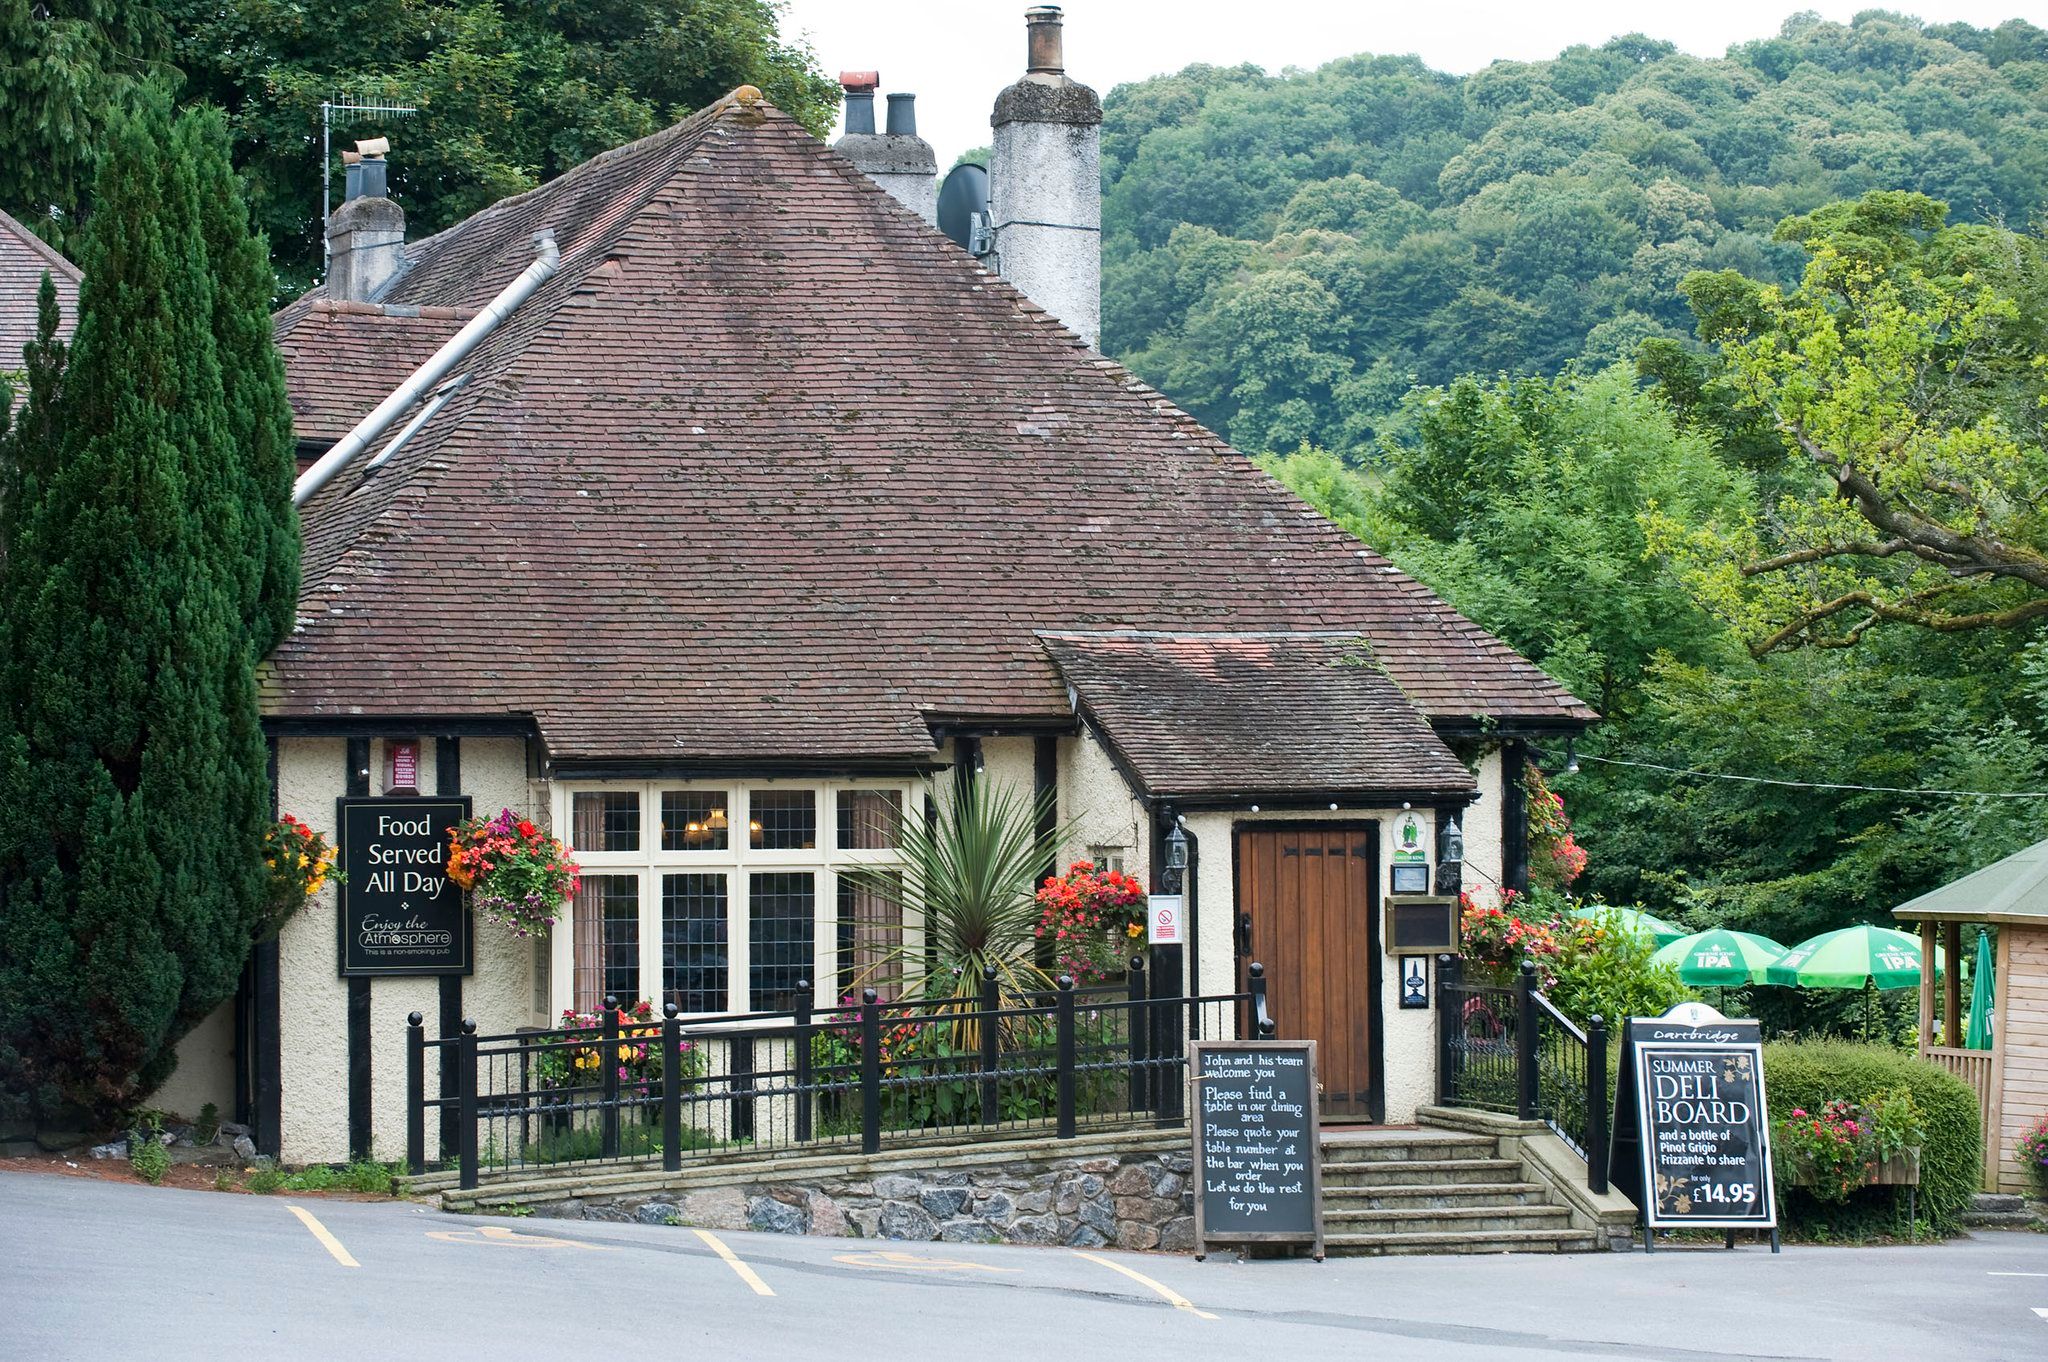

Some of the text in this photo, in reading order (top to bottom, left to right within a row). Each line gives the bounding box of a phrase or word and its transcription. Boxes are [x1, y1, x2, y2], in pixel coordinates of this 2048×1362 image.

[379, 814, 431, 836] Food
[368, 842, 441, 865] Served
[365, 871, 446, 900] All Day
[362, 913, 428, 935] Enjoy the
[364, 933, 450, 945] Atmosphere
[1697, 956, 1732, 968] IPA
[1882, 956, 1922, 970] IPA
[1654, 1028, 1739, 1043] Dartbridge
[1205, 1055, 1303, 1066] John and his team
[1653, 1060, 1716, 1074] SUMMER
[1205, 1066, 1276, 1082] welcome you
[1205, 1086, 1286, 1100] Please find a
[1655, 1075, 1720, 1100] DELI
[1204, 1100, 1302, 1118] table in our dining
[1657, 1101, 1750, 1124] BOARD
[1241, 1113, 1264, 1122] area
[1206, 1124, 1300, 1143] Please quote your
[1659, 1130, 1731, 1141] and a bottle of
[1206, 1141, 1296, 1155] table number at
[1660, 1142, 1717, 1154] Pinot Grigio
[1206, 1156, 1303, 1176] the bar when you
[1661, 1154, 1745, 1165] Frizzante to share
[1236, 1170, 1262, 1181] order
[1699, 1175, 1711, 1183] only
[1207, 1181, 1226, 1193] Let
[1243, 1182, 1255, 1194] do
[1258, 1183, 1275, 1194] the
[1279, 1182, 1303, 1194] rest
[1693, 1183, 1756, 1203] £14.95
[1229, 1197, 1267, 1216] for you
